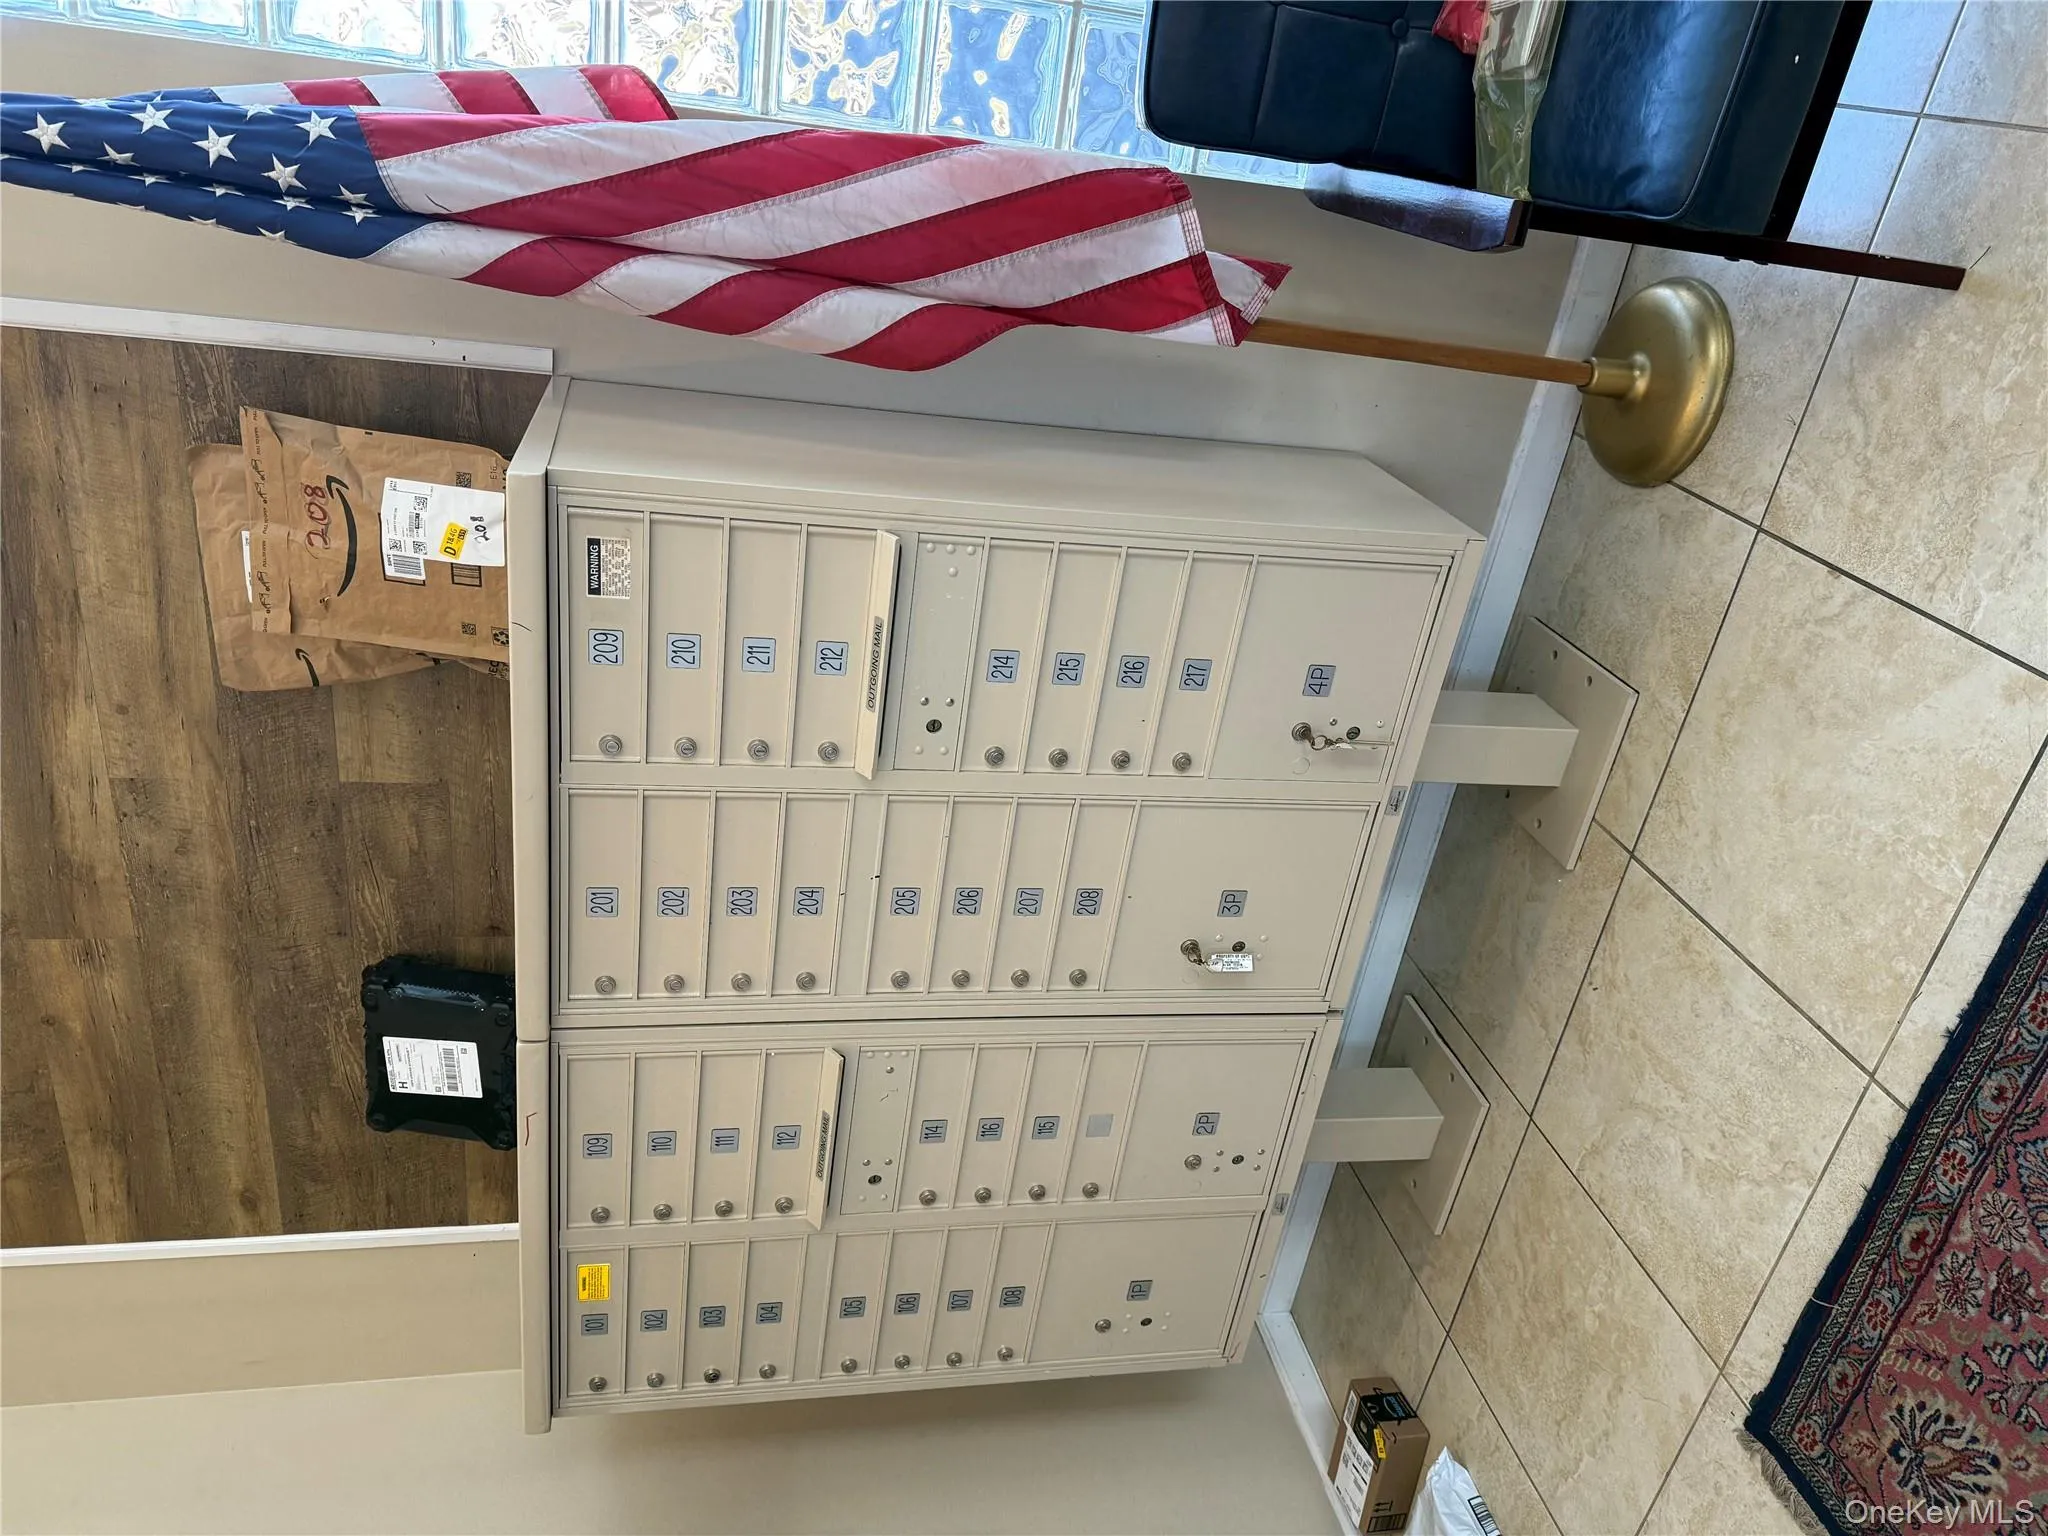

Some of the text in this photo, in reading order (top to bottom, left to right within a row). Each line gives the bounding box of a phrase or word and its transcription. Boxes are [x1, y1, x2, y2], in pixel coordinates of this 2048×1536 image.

[304, 483, 330, 548] 208
[443, 546, 457, 556] D
[590, 544, 599, 589] WARNING
[592, 632, 619, 664] 209
[670, 639, 696, 665] 210
[746, 645, 771, 666] 211
[819, 647, 844, 672] 212
[867, 621, 883, 709] OUTGOING MAIL
[990, 654, 1015, 679] 214
[1056, 658, 1081, 682] 215
[1120, 660, 1145, 685] 216
[1183, 663, 1207, 687] 217
[1308, 667, 1330, 695] 4P
[590, 892, 614, 914] 201
[661, 889, 685, 916] 202
[729, 889, 754, 916] 203
[796, 888, 821, 915] 204
[893, 889, 917, 915] 205
[956, 889, 980, 915] 206
[1017, 890, 1040, 915] 207
[1076, 890, 1100, 915] 208
[1221, 893, 1242, 915] 3P
[398, 1081, 409, 1089] H
[923, 1125, 944, 1140] 114
[980, 1122, 1002, 1138] 116
[1037, 1121, 1056, 1135] 115
[1195, 1114, 1215, 1134] 2P
[586, 1137, 609, 1157] 109
[651, 1136, 673, 1152] 110
[714, 1135, 735, 1147] 111
[776, 1130, 797, 1146] 112
[816, 1116, 830, 1178] OUTGOING MAIL
[950, 1293, 969, 1310] 107
[1002, 1289, 1022, 1306] 108
[1129, 1283, 1148, 1299] 1P
[759, 1303, 780, 1322] 104
[842, 1298, 864, 1317] 105
[897, 1295, 918, 1313] 106
[584, 1318, 605, 1332] 101
[643, 1312, 664, 1330] 102
[702, 1309, 723, 1326] 103
